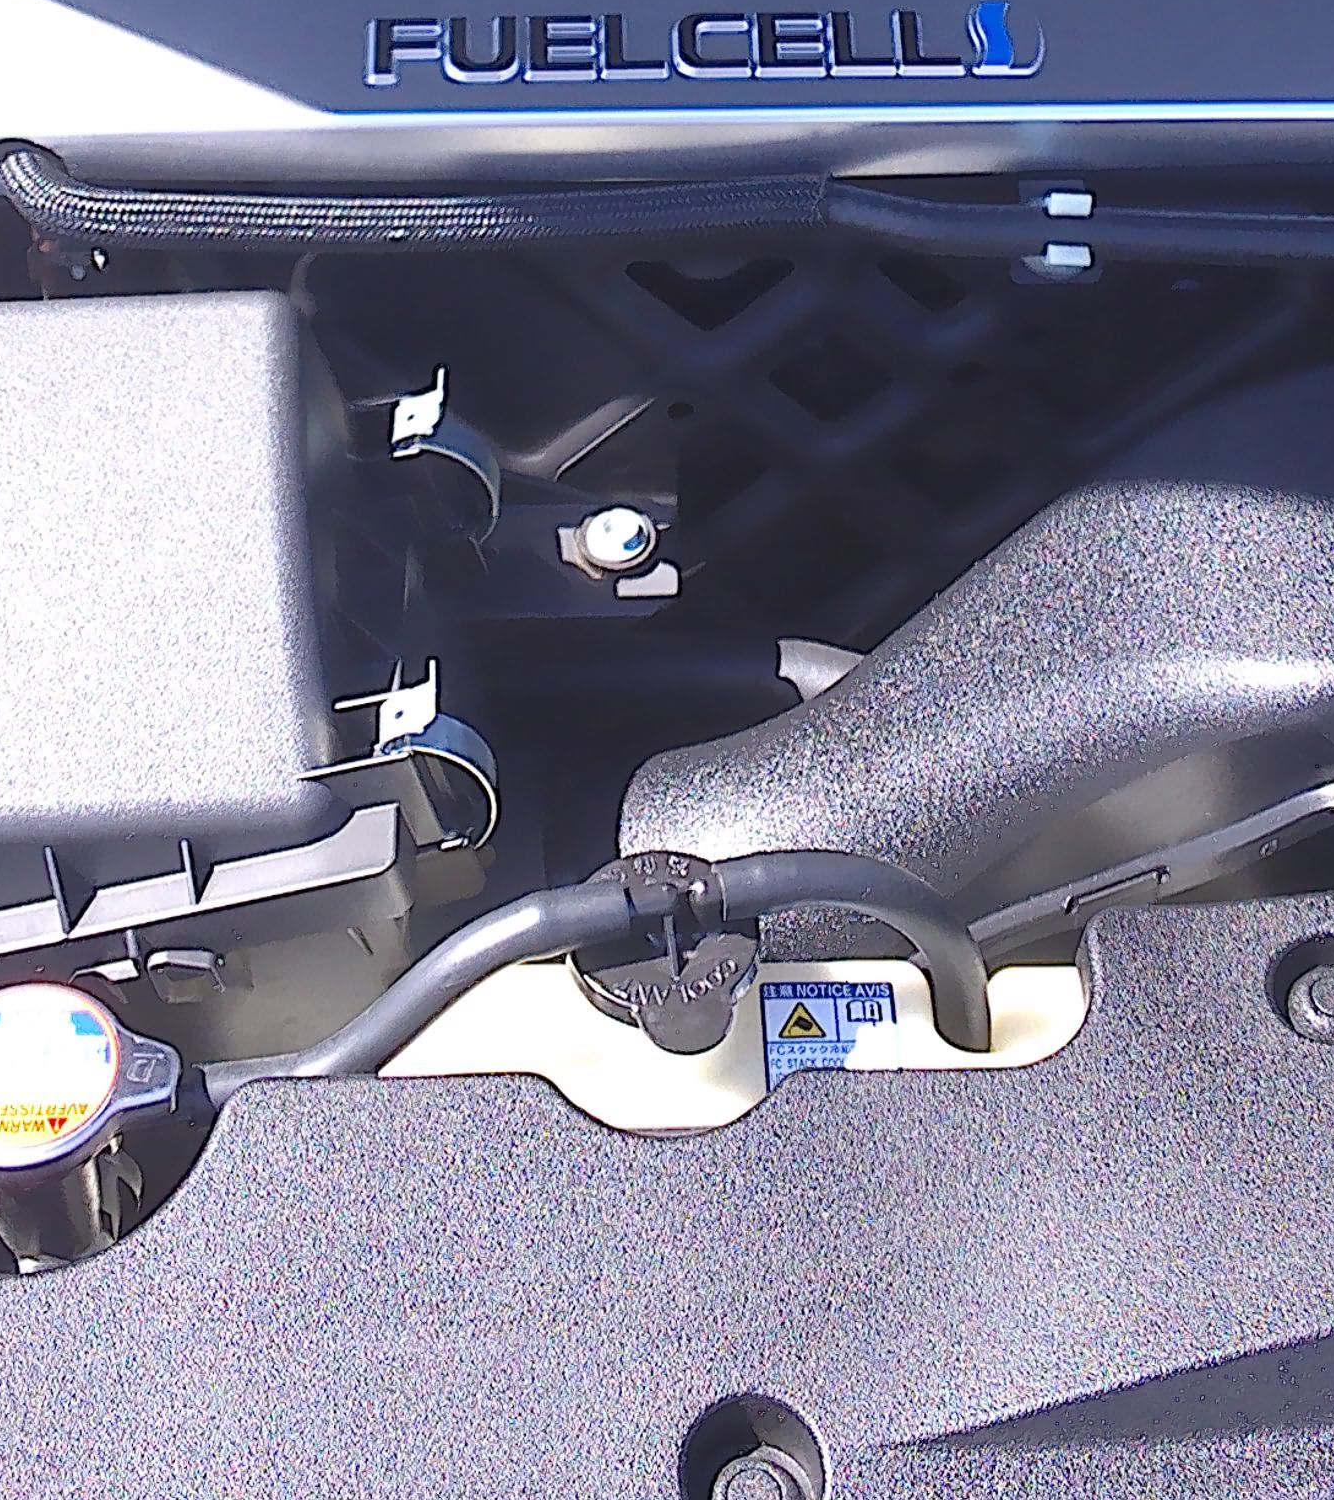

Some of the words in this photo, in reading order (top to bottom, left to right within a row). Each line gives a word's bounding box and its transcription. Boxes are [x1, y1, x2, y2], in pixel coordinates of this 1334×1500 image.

[613, 959, 738, 1006] COOLANT
[796, 984, 852, 998] NOTICE
[855, 984, 890, 998] AVIS
